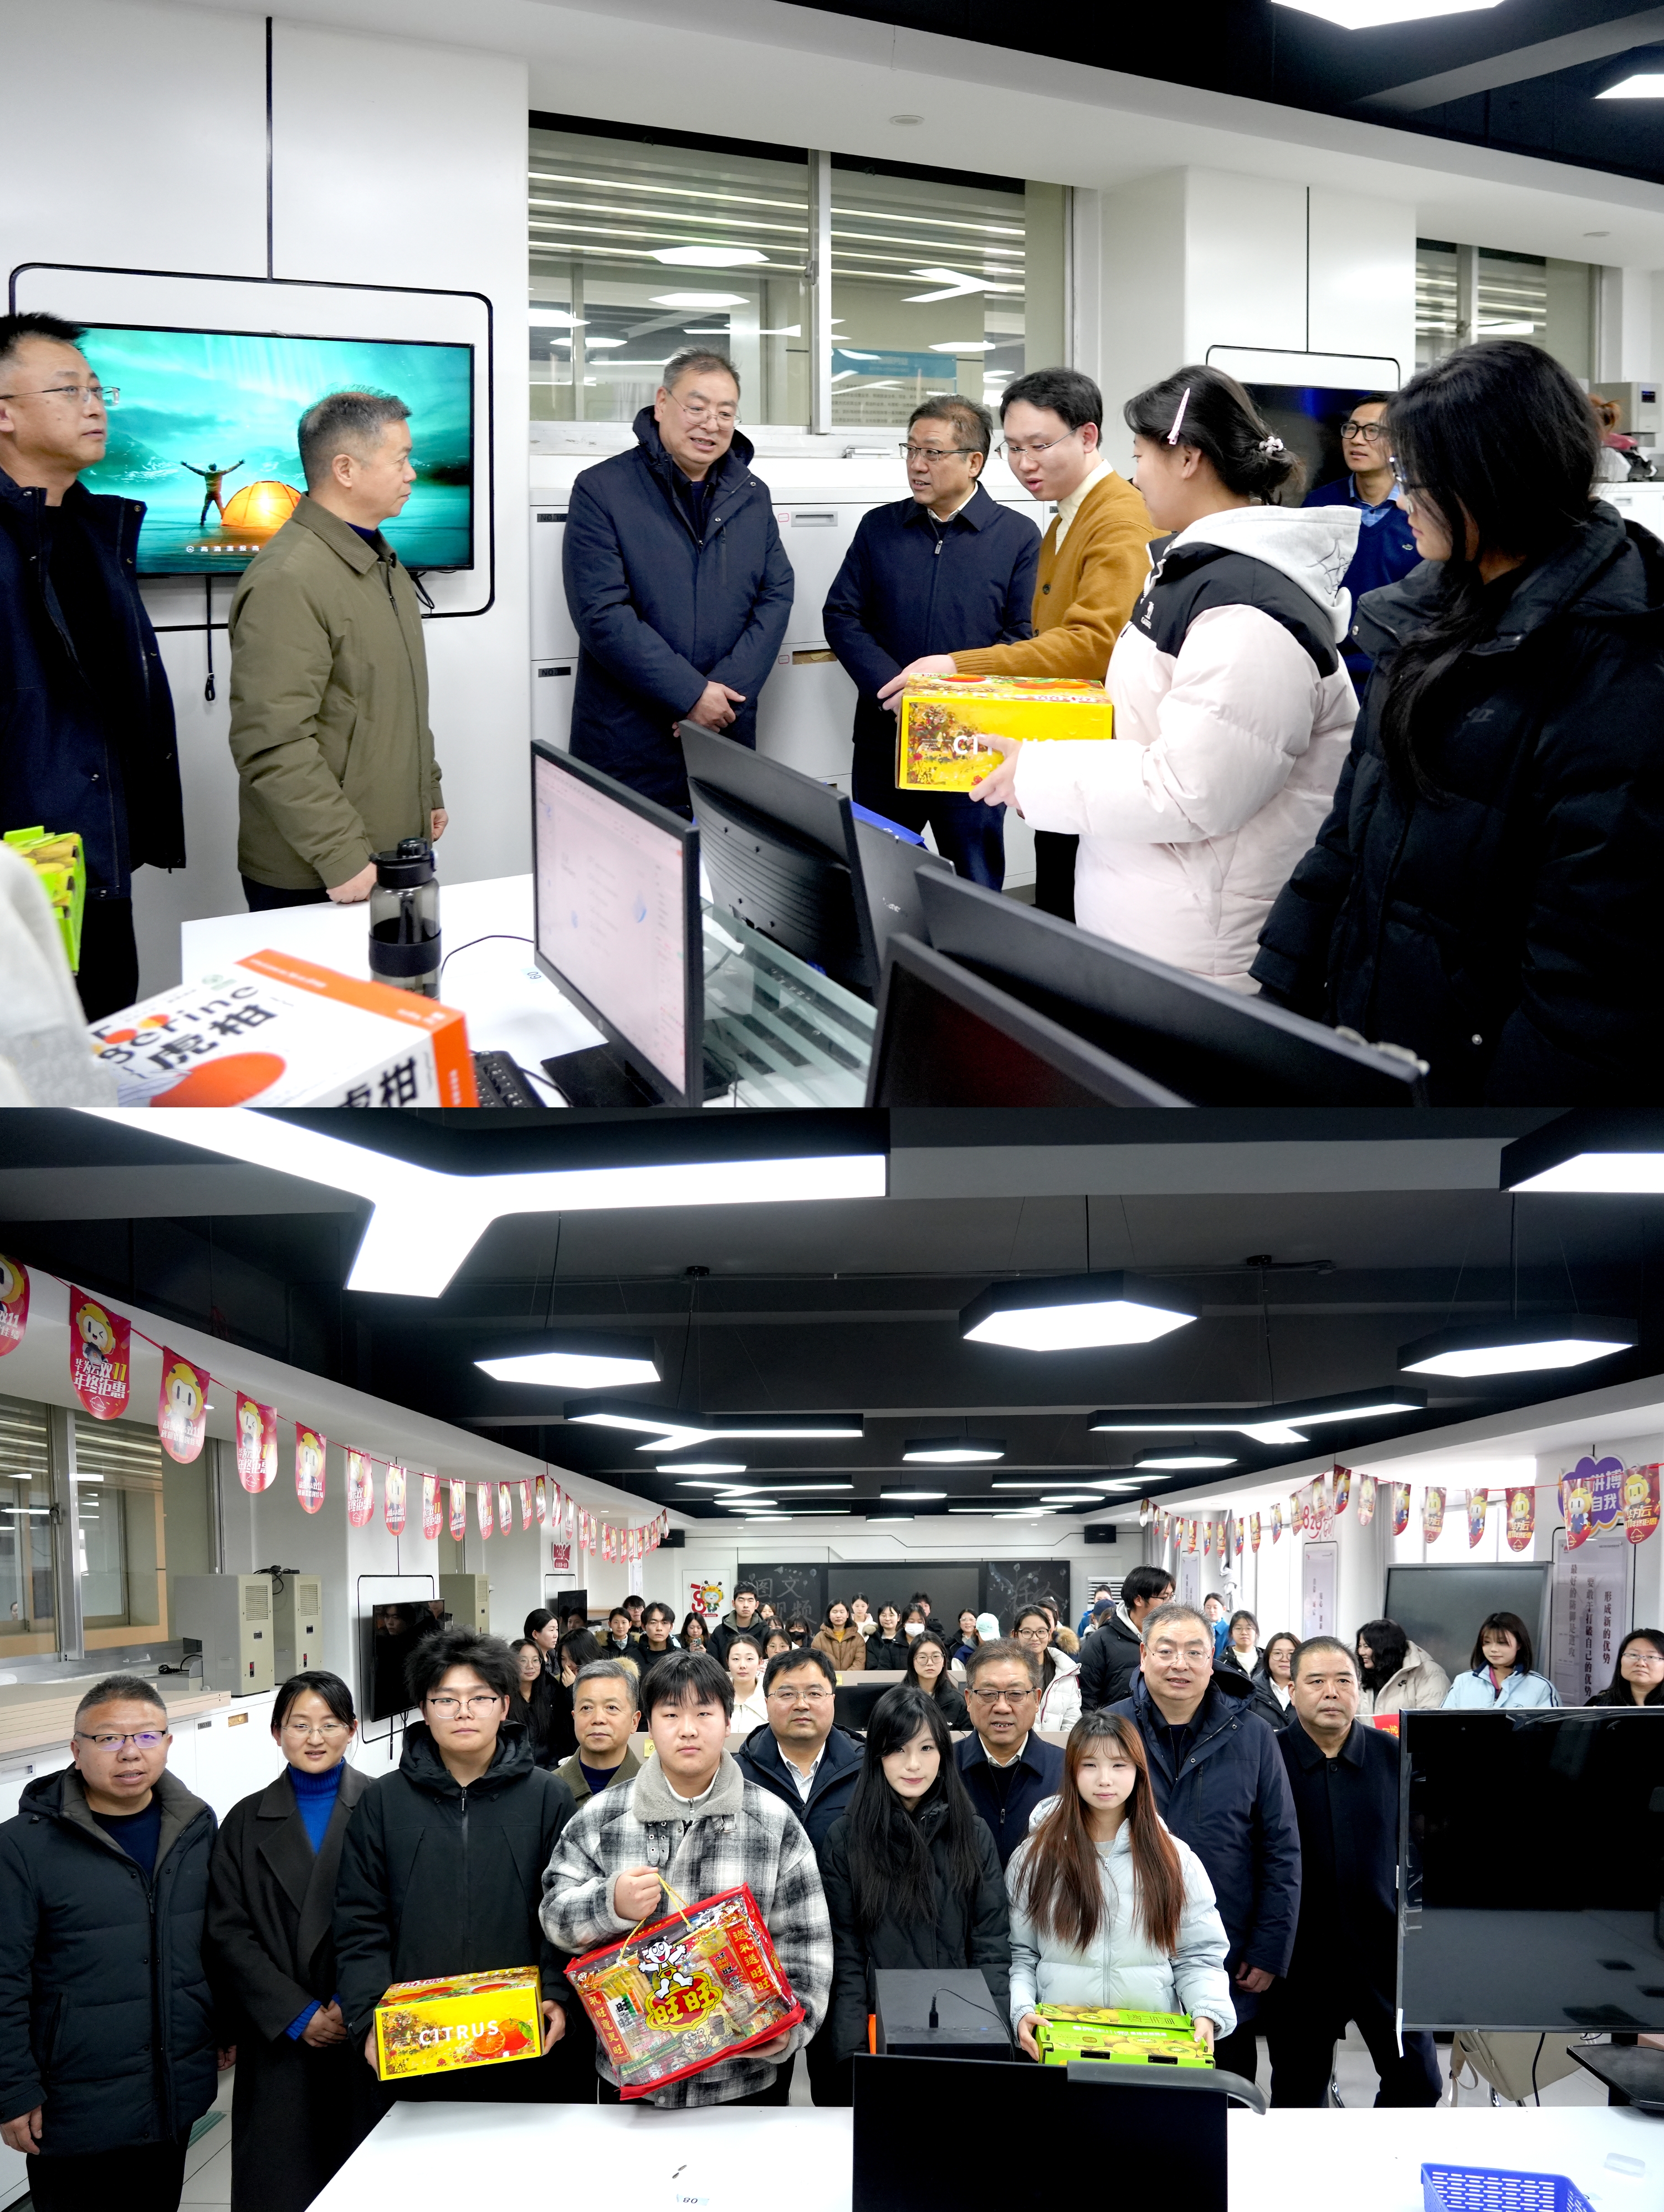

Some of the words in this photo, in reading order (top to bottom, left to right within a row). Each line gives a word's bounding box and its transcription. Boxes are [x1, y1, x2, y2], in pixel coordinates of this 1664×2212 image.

[74, 1371, 127, 1399] 年终钜惠
[75, 1358, 127, 1381] 华为云双11
[1591, 1493, 1617, 1513] 自我
[1626, 1505, 1652, 1519] 华为云
[1584, 1577, 1594, 1697] 要敢于打破自己的优势
[1602, 1591, 1612, 1664] 形成新的优势
[733, 1929, 771, 1991] 送礼送旺旺
[651, 1981, 715, 2026] 旺旺
[419, 2020, 499, 2045] CITRUS
[588, 1995, 624, 2055] 礼旺意更旺
